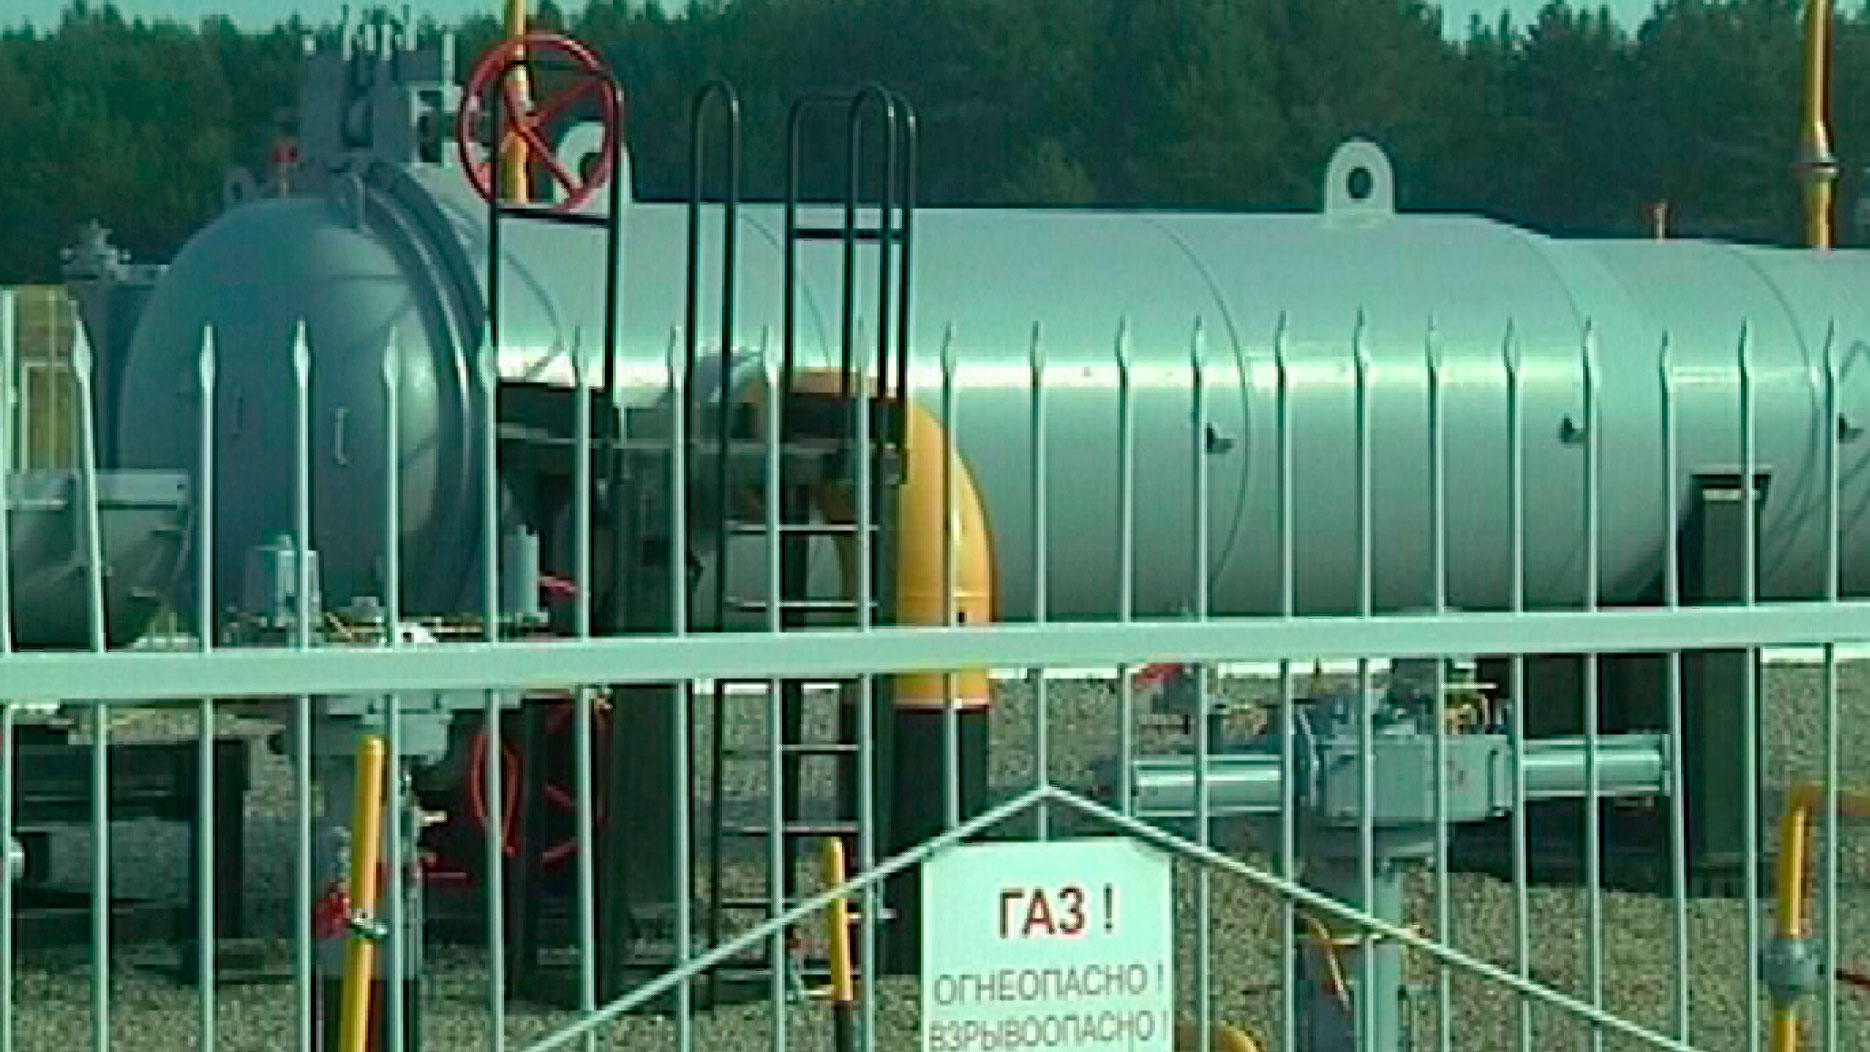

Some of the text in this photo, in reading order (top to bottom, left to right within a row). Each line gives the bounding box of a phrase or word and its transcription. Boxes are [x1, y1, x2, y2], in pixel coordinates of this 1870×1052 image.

[999, 886, 1086, 938] ГАЗ
[934, 963, 1148, 1006] ОГНЕОПАСНО
[930, 1010, 1155, 1051] ВЗРЫВООПАСНО
